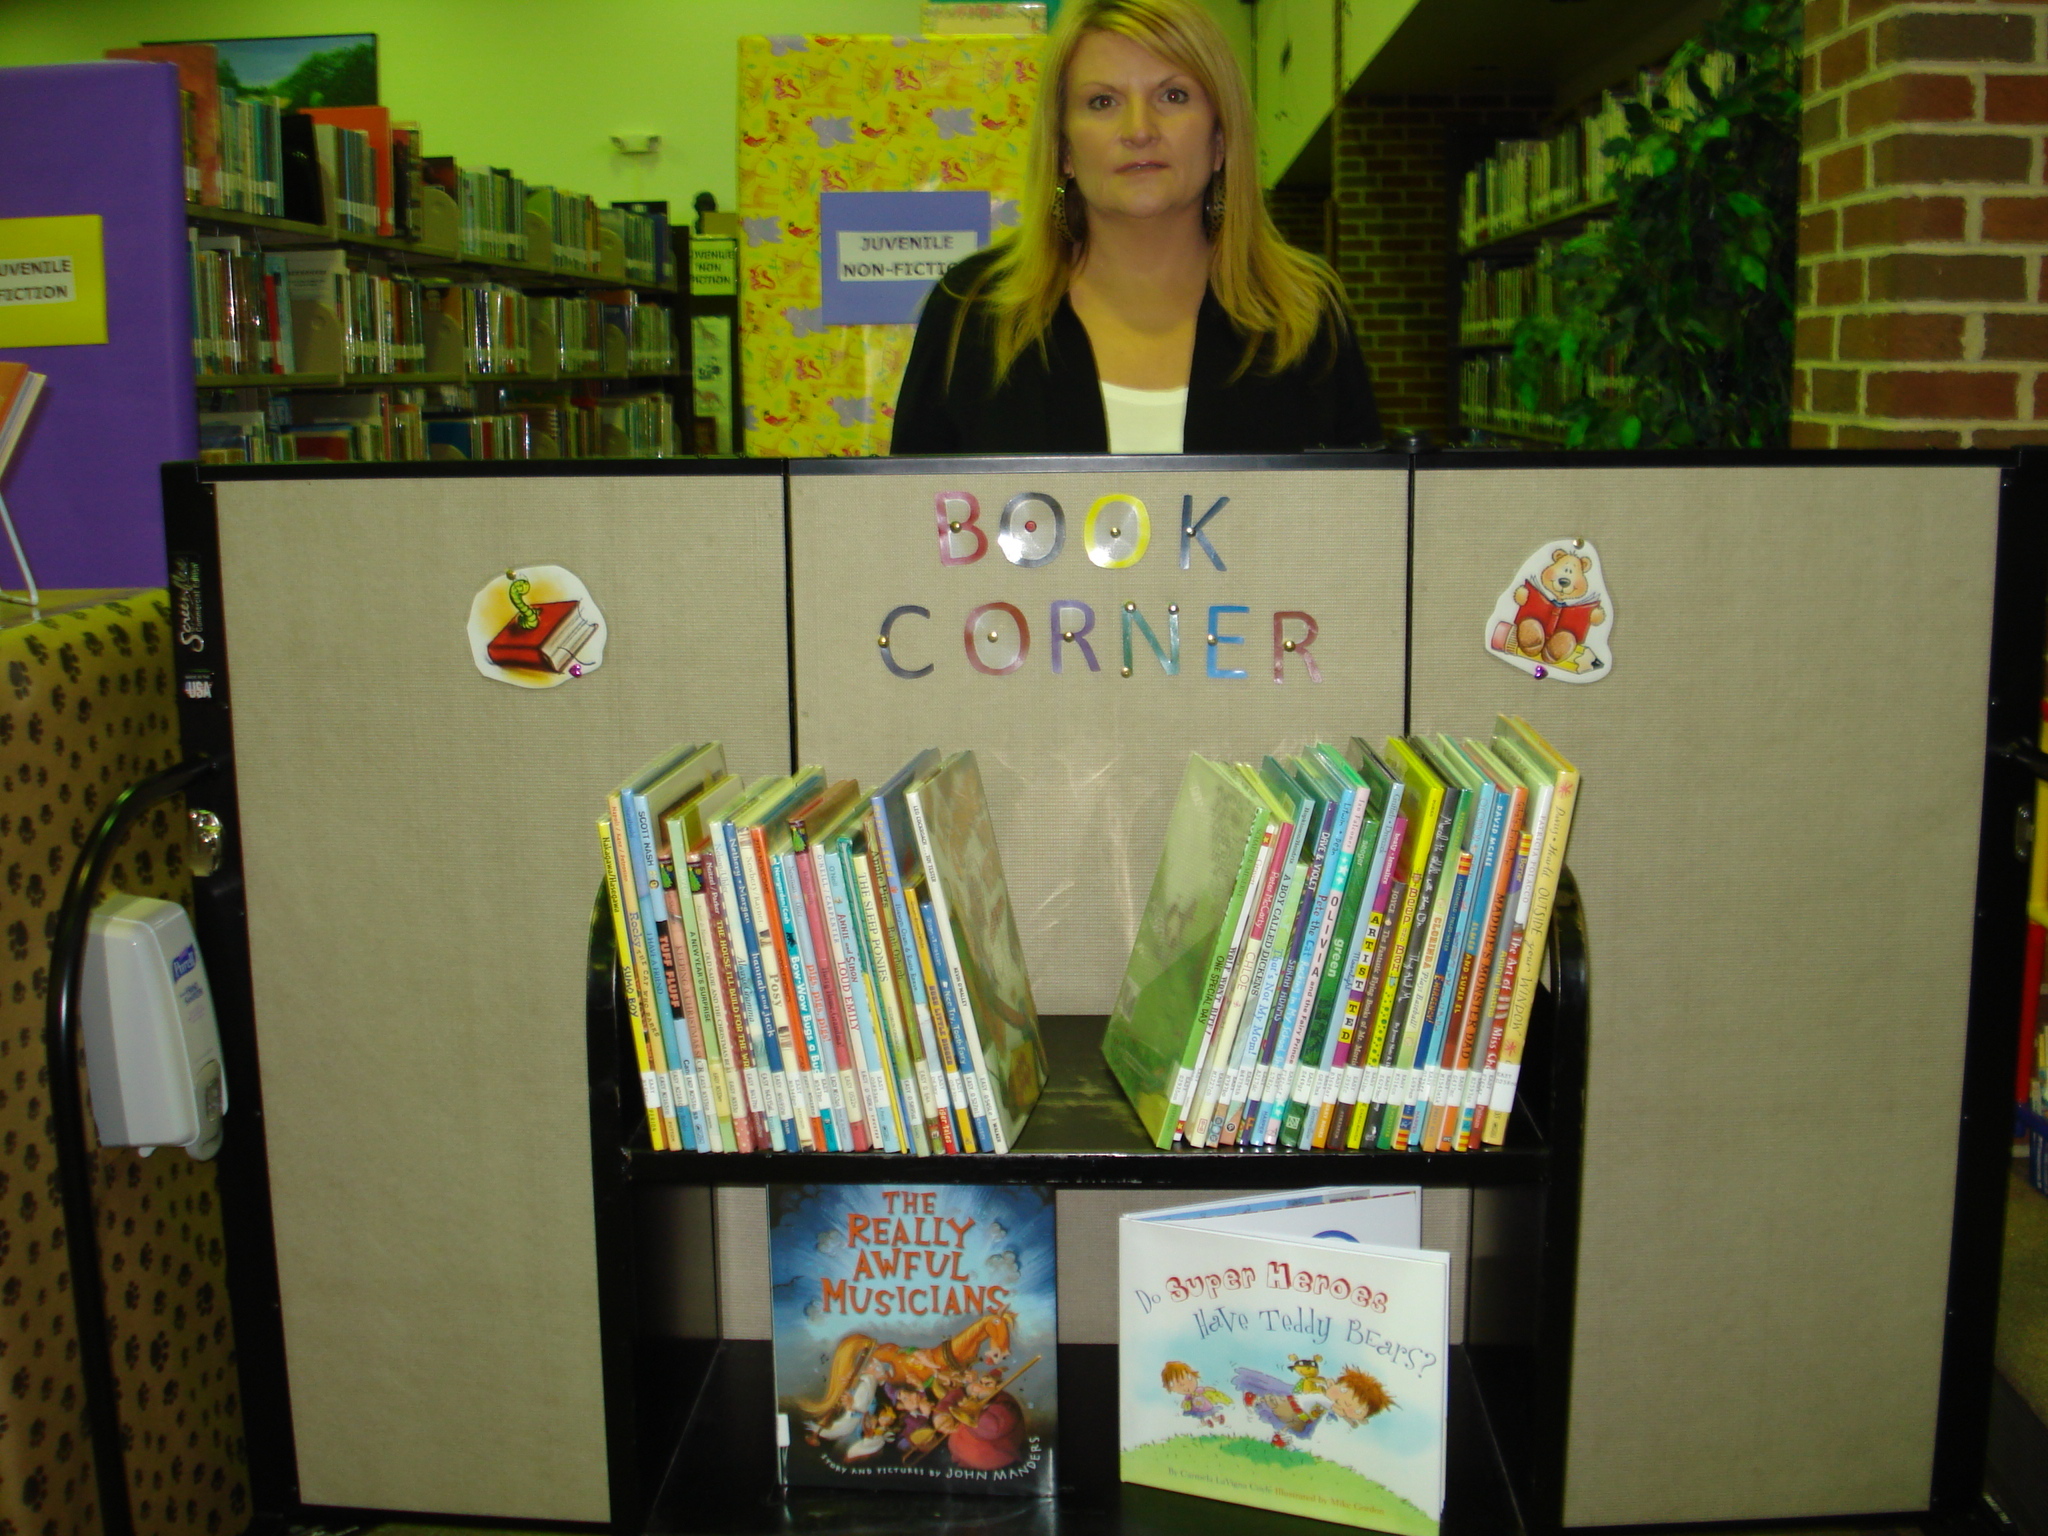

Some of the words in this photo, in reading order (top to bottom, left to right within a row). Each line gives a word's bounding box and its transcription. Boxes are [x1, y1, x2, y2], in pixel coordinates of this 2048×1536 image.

[862, 236, 953, 251] JUVENILE
[0, 260, 72, 277] UVENILE
[934, 491, 1231, 572] BOOK
[878, 601, 1323, 684] CORNER
[184, 680, 212, 699] USA
[637, 810, 649, 839] SCOTT
[1490, 805, 1503, 834] DAVID
[1317, 830, 1330, 852] DAVE
[1389, 832, 1400, 851] beaty
[1531, 815, 1546, 857] PATRICIA
[643, 841, 654, 866] NASH
[727, 837, 741, 876] Nethery
[870, 849, 884, 882] Apple
[705, 861, 715, 884] Neitzel
[857, 871, 870, 897] THE
[1266, 870, 1279, 893] Peter
[1307, 863, 1321, 892] VIOLET
[1522, 861, 1537, 903] POLACCO
[711, 891, 722, 914] Parker
[736, 885, 751, 923] Morgan
[877, 884, 890, 908] Pigs
[1276, 883, 1288, 905] BOY
[1312, 894, 1327, 917] Pete
[1387, 889, 1399, 914] JOYCE
[863, 900, 878, 934] SLEEP
[1254, 892, 1272, 929] McCarty
[1529, 886, 1551, 936] OUTSIDE
[628, 911, 643, 948] Rocky
[715, 920, 725, 938] THE
[836, 913, 849, 940] ANNIE
[887, 925, 898, 947] Ruth
[1263, 906, 1282, 949] CALLED
[1307, 919, 1320, 937] the
[1310, 894, 1339, 977] OLIVIA
[1380, 929, 1390, 943] The
[1466, 921, 1479, 950] ELMER
[1481, 892, 1504, 960] MADDIE'S
[659, 935, 673, 967] TUFF
[690, 937, 700, 957] NEW
[719, 939, 731, 969] HOUSE
[844, 941, 852, 954] and
[1302, 939, 1314, 957] Cat
[1353, 914, 1380, 990] ARTIST
[1422, 916, 1442, 970] CLORINDA
[1508, 935, 1522, 954] The
[1517, 938, 1536, 971] your
[635, 948, 646, 966] THE
[704, 951, 712, 966] OLD
[824, 895, 839, 943] CARPENTER
[837, 960, 851, 992] LOUD
[844, 995, 859, 1031] EMILY
[845, 955, 858, 983] SIMON
[871, 938, 888, 982] PONIES
[892, 948, 905, 979] Orbach
[1213, 954, 1224, 972] ONE
[1267, 947, 1283, 980] That's
[1325, 937, 1344, 978] green
[1372, 945, 1386, 974] Fantastic
[1461, 953, 1472, 973] AND
[1493, 950, 1507, 985] Animal
[1504, 957, 1517, 975] Art
[622, 965, 634, 994] SUMO
[641, 969, 650, 986] CAT
[652, 966, 663, 995] FRIEND
[694, 957, 705, 984] YEAR'S
[707, 966, 716, 987] SADIE
[750, 951, 767, 992] hannah
[1236, 950, 1256, 991] CHLOE
[1250, 949, 1269, 996] DICKENS
[1282, 958, 1296, 988] SARAH
[664, 969, 680, 1008] FLUFF
[711, 988, 719, 1003] AND
[767, 972, 784, 1009] Posy
[1202, 972, 1219, 1006] SPECIAL
[1261, 981, 1274, 1001] Not
[1306, 980, 1315, 997] and
[1366, 975, 1378, 997] Flying
[1455, 975, 1467, 1001] SUPER
[1467, 962, 1489, 1028] MONSTER
[1501, 978, 1513, 991] of
[627, 997, 638, 1018] BOY
[641, 990, 650, 1008] WHO
[699, 985, 711, 1022] SURPRISE
[713, 1004, 722, 1018] THE
[729, 987, 739, 1013] BUILD
[742, 985, 757, 1022] Gramma
[760, 993, 768, 1009] and
[790, 955, 809, 1011] Bow-Wow
[800, 1014, 815, 1041] Bugs
[943, 990, 953, 1006] Nice
[1273, 990, 1288, 1022] ADAMS
[1302, 999, 1311, 1013] the
[1362, 999, 1373, 1018] Books
[1486, 986, 1499, 1017] Baths
[1509, 976, 1532, 1031] WINDOW
[645, 1010, 659, 1038] BARKS
[733, 1013, 743, 1032] FOR
[761, 1009, 775, 1037] jack
[933, 1007, 946, 1036] LITTLE
[1197, 1007, 1208, 1024] DAY
[1251, 1003, 1268, 1022] My
[1294, 1014, 1307, 1036] Fairy
[1340, 1003, 1357, 1040] TED
[716, 1018, 728, 1057] CHRISTMAS
[737, 1033, 747, 1051] THE
[816, 1016, 830, 1042] pigs!
[952, 1024, 963, 1045] Tooth
[1246, 1024, 1263, 1055] Mom!
[1488, 1026, 1502, 1050] Miss
[956, 1046, 968, 1064] Fairy
[1288, 1037, 1301, 1064] Prince
[1460, 1032, 1474, 1059] DAD
[760, 1072, 768, 1086] EASY
[903, 1079, 911, 1092] EASY
[965, 1076, 973, 1090] EASY
[979, 1077, 987, 1090] EASY
[1305, 1071, 1313, 1086] EASY
[1350, 1075, 1358, 1091] EASY
[942, 1124, 954, 1143] tales
[992, 1122, 1001, 1142] WALKER
[1257, 1110, 1267, 1134] HARPER
[1410, 1110, 1420, 1133] HARPER
[882, 1191, 937, 1215] THE
[847, 1213, 976, 1250] REALLY
[853, 1248, 969, 1282] AWFUL
[820, 1277, 1010, 1316] MUSICIANS
[1135, 1289, 1162, 1314] Do
[1165, 1266, 1256, 1303] Super
[1266, 1261, 1388, 1314] Heroes
[1258, 1306, 1333, 1344] Teddy
[820, 1453, 847, 1474] STORY
[851, 1467, 872, 1476] AND
[877, 1466, 925, 1476] PICTURES
[929, 1469, 942, 1478] BY
[946, 1467, 988, 1481] JOHN
[993, 1436, 1041, 1481] MANDERS
[1275, 1487, 1317, 1503] Illustrated
[1330, 1497, 1352, 1510] Mike
